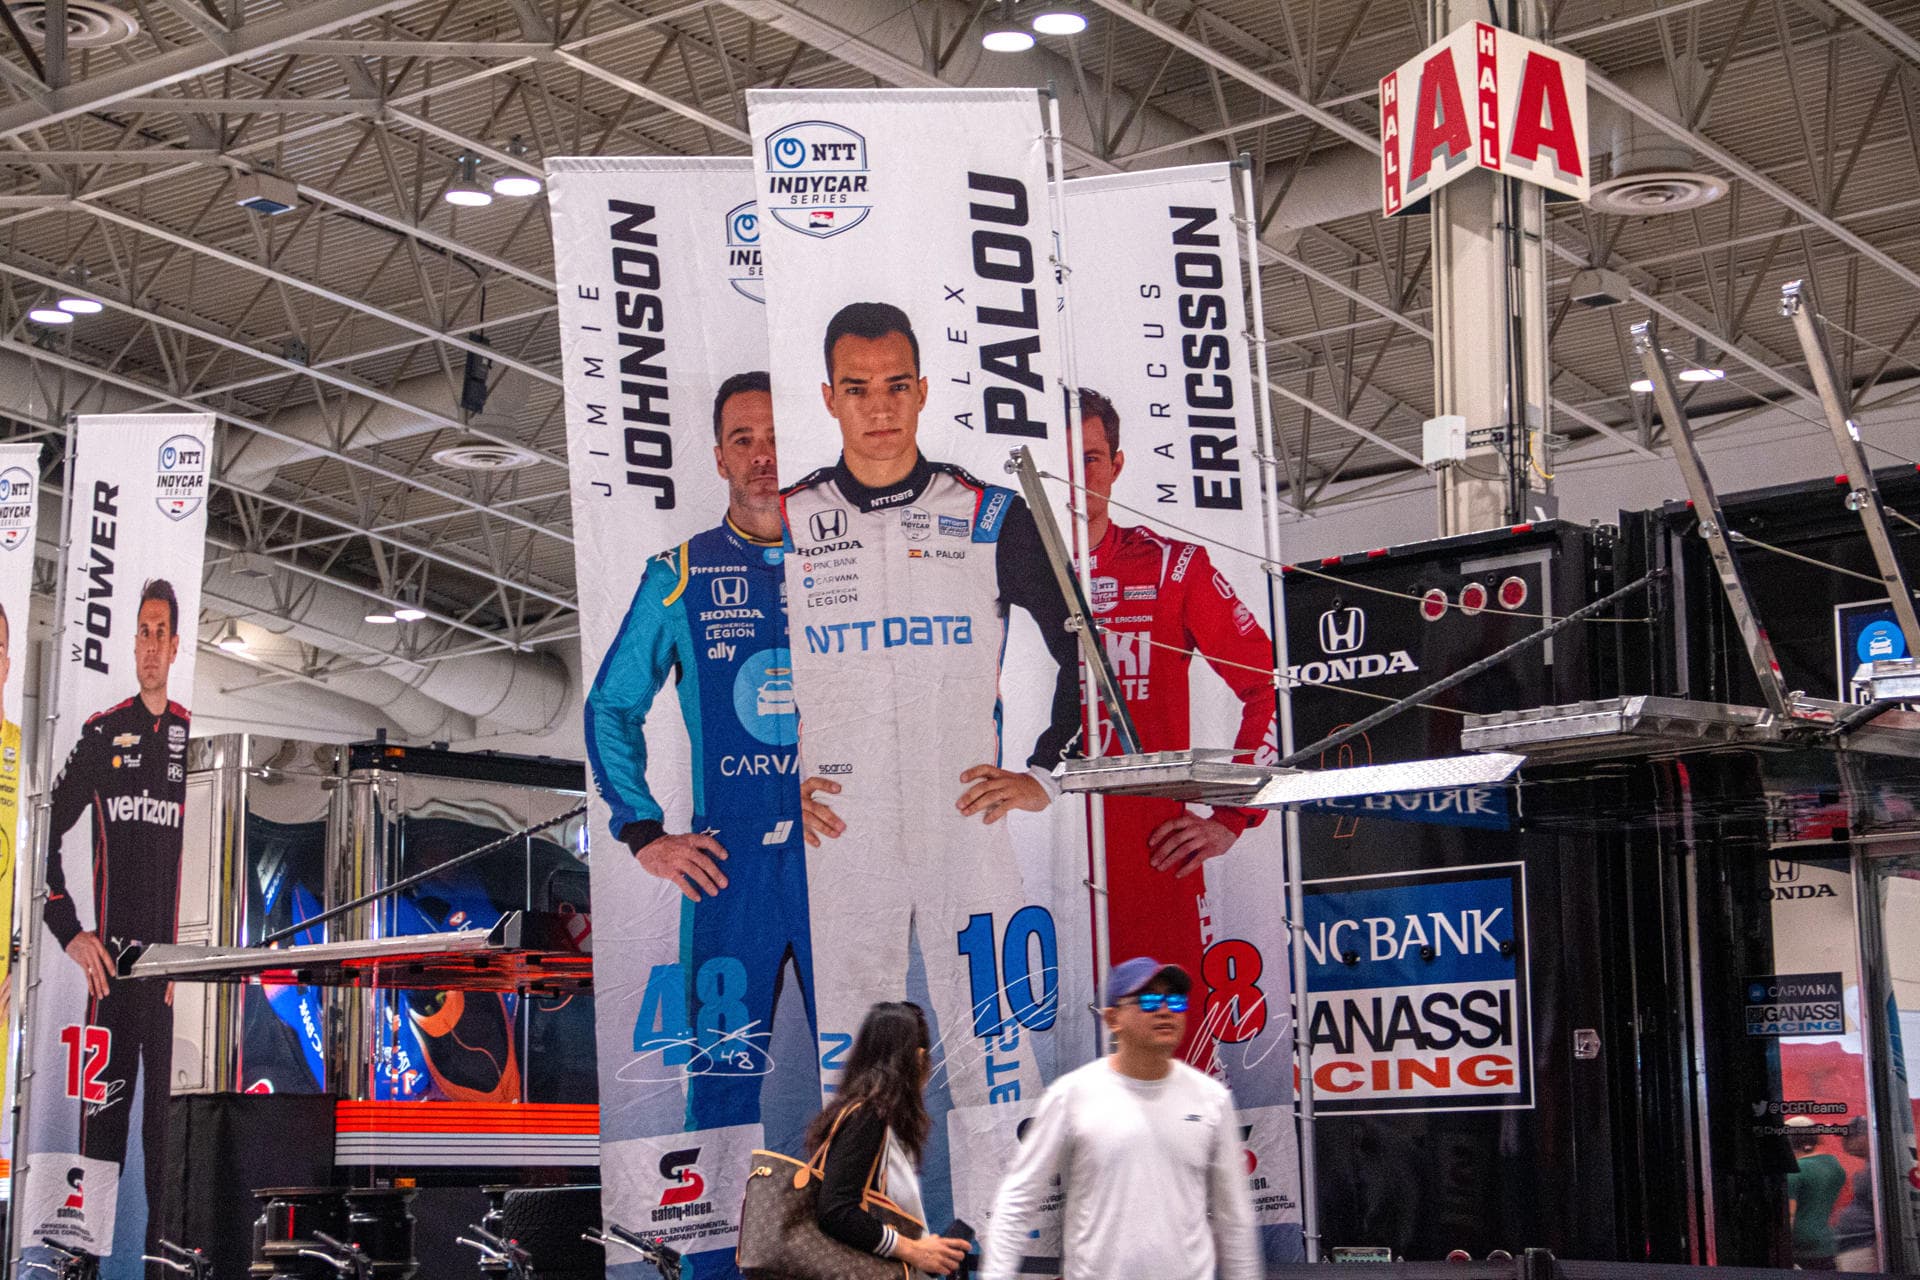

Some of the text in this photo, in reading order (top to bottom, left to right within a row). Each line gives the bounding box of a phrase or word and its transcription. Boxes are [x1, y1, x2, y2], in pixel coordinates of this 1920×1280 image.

[1479, 29, 1497, 165] HALL
[1405, 46, 1472, 190] A
[1507, 50, 1583, 180] A
[811, 143, 857, 161] NTT
[1384, 79, 1399, 208] HALL
[769, 175, 869, 193] INDYCAR
[790, 194, 847, 205] SERIES
[967, 171, 1048, 439] PALOU
[608, 199, 676, 510] JOHNSON
[944, 285, 974, 430] ALEX
[1168, 205, 1242, 510] ERICSSON
[578, 285, 612, 497] JIMMIE
[1140, 284, 1178, 503] MARCUS
[179, 451, 201, 465] NTT
[11, 483, 30, 496] NTT
[157, 475, 203, 488] INDYCAR
[165, 488, 192, 496] SERIES
[0, 505, 31, 518] NDYCAR
[980, 493, 1008, 532] sparco
[797, 540, 863, 557] HONDA
[936, 550, 966, 559] PALOU
[690, 565, 748, 576] Firestone
[813, 557, 858, 570] PNC BANK
[1170, 544, 1198, 583] sparco
[84, 480, 119, 674] POWER
[816, 573, 859, 585] CARVANA
[807, 593, 858, 608] LEGION
[71, 562, 88, 662] WILL
[699, 609, 765, 621] HONDA
[706, 628, 755, 640] LEGION
[805, 621, 876, 654] NTT
[707, 642, 737, 662] ally
[1273, 651, 1419, 689] HONDA
[818, 763, 853, 774] sparco
[107, 789, 180, 828] verizon
[1363, 907, 1504, 962] BANK
[957, 904, 1059, 1038] 10
[1202, 939, 1267, 1044] 8
[1768, 984, 1838, 998] CARVANA
[633, 956, 750, 1067] 48
[1764, 1004, 1840, 1022] GANASSI
[1293, 990, 1513, 1057] ANASSI
[1748, 1021, 1841, 1033] RACING
[61, 1024, 111, 1103] 12
[721, 1049, 754, 1070] 48
[1768, 1102, 1847, 1114] @CGRTeams
[670, 1219, 729, 1233] ENVIRONMENTAL
[708, 1226, 739, 1237] INDYCAR
